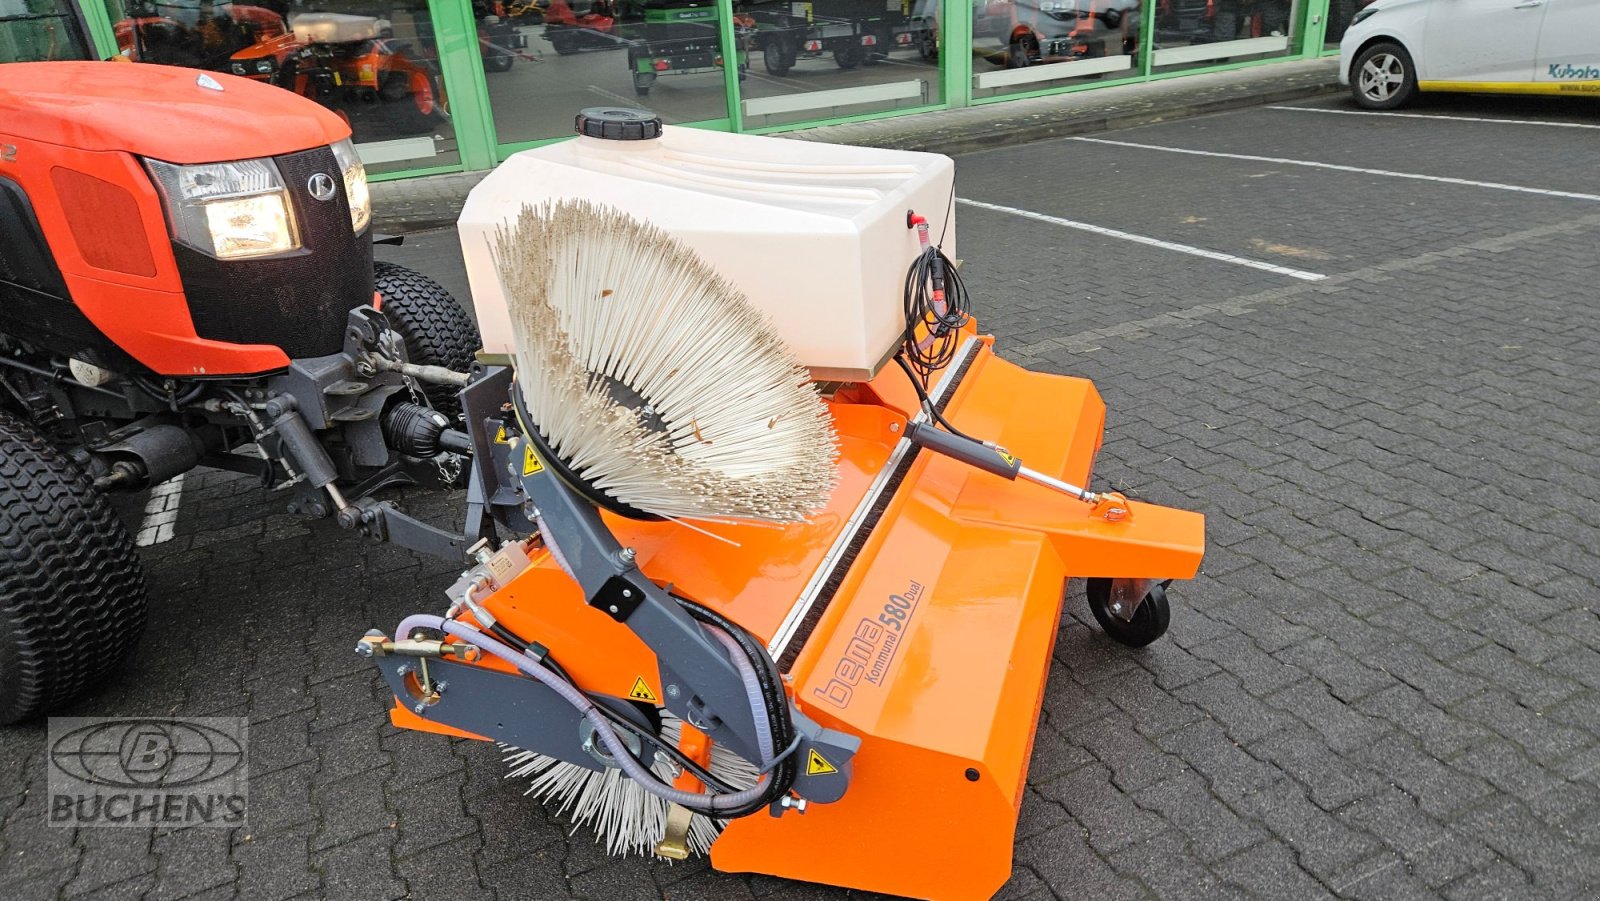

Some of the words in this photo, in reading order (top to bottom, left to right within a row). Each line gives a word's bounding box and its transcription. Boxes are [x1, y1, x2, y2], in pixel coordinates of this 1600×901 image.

[1548, 63, 1599, 79] Kubota
[0, 143, 17, 163] 2
[903, 579, 921, 601] Dual
[878, 594, 912, 631] 580
[813, 617, 884, 709] bema
[864, 630, 899, 684] Kommunal
